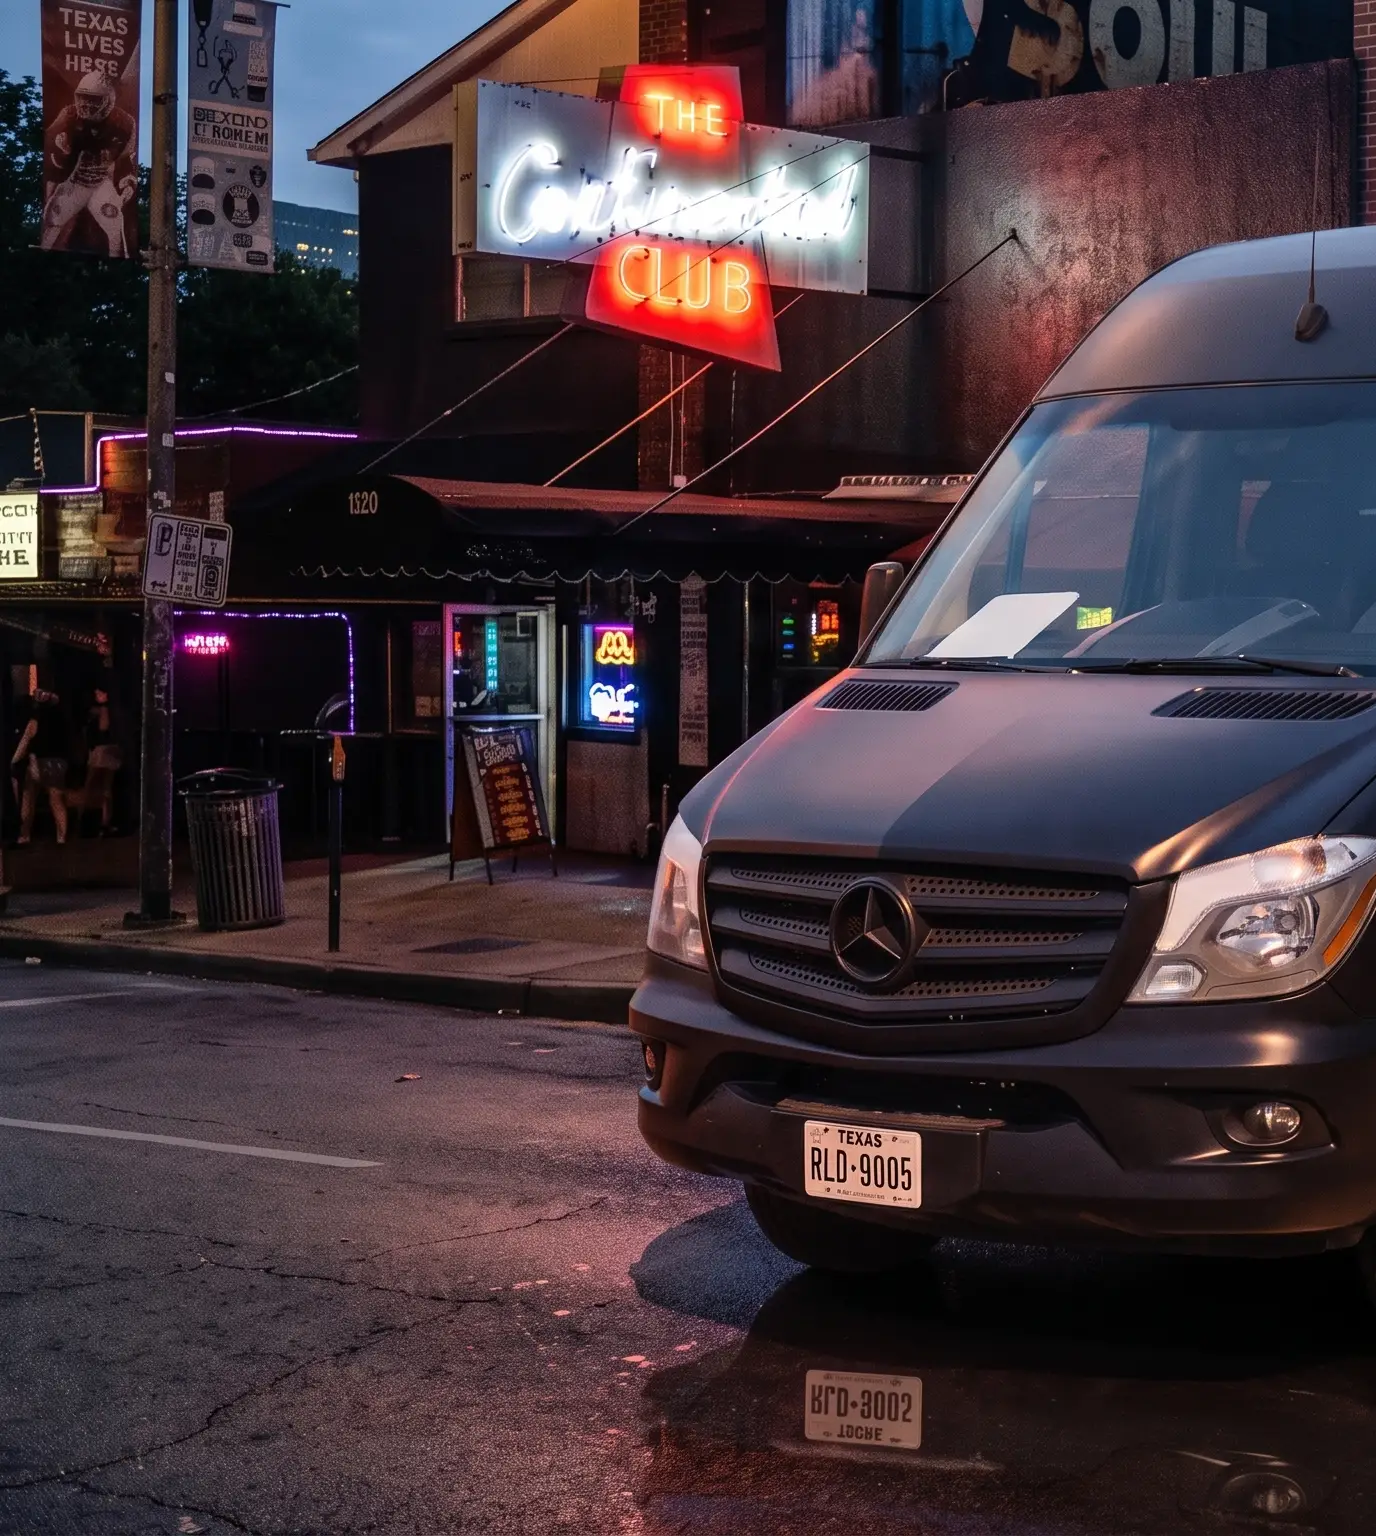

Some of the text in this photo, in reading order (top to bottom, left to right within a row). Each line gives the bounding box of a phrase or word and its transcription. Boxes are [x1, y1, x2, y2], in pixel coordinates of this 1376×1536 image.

[59, 7, 128, 35] TEXAS
[64, 30, 125, 57] LIVES
[645, 94, 728, 136] THE
[618, 245, 752, 314] CLUB
[838, 1129, 882, 1148] TEXAS
